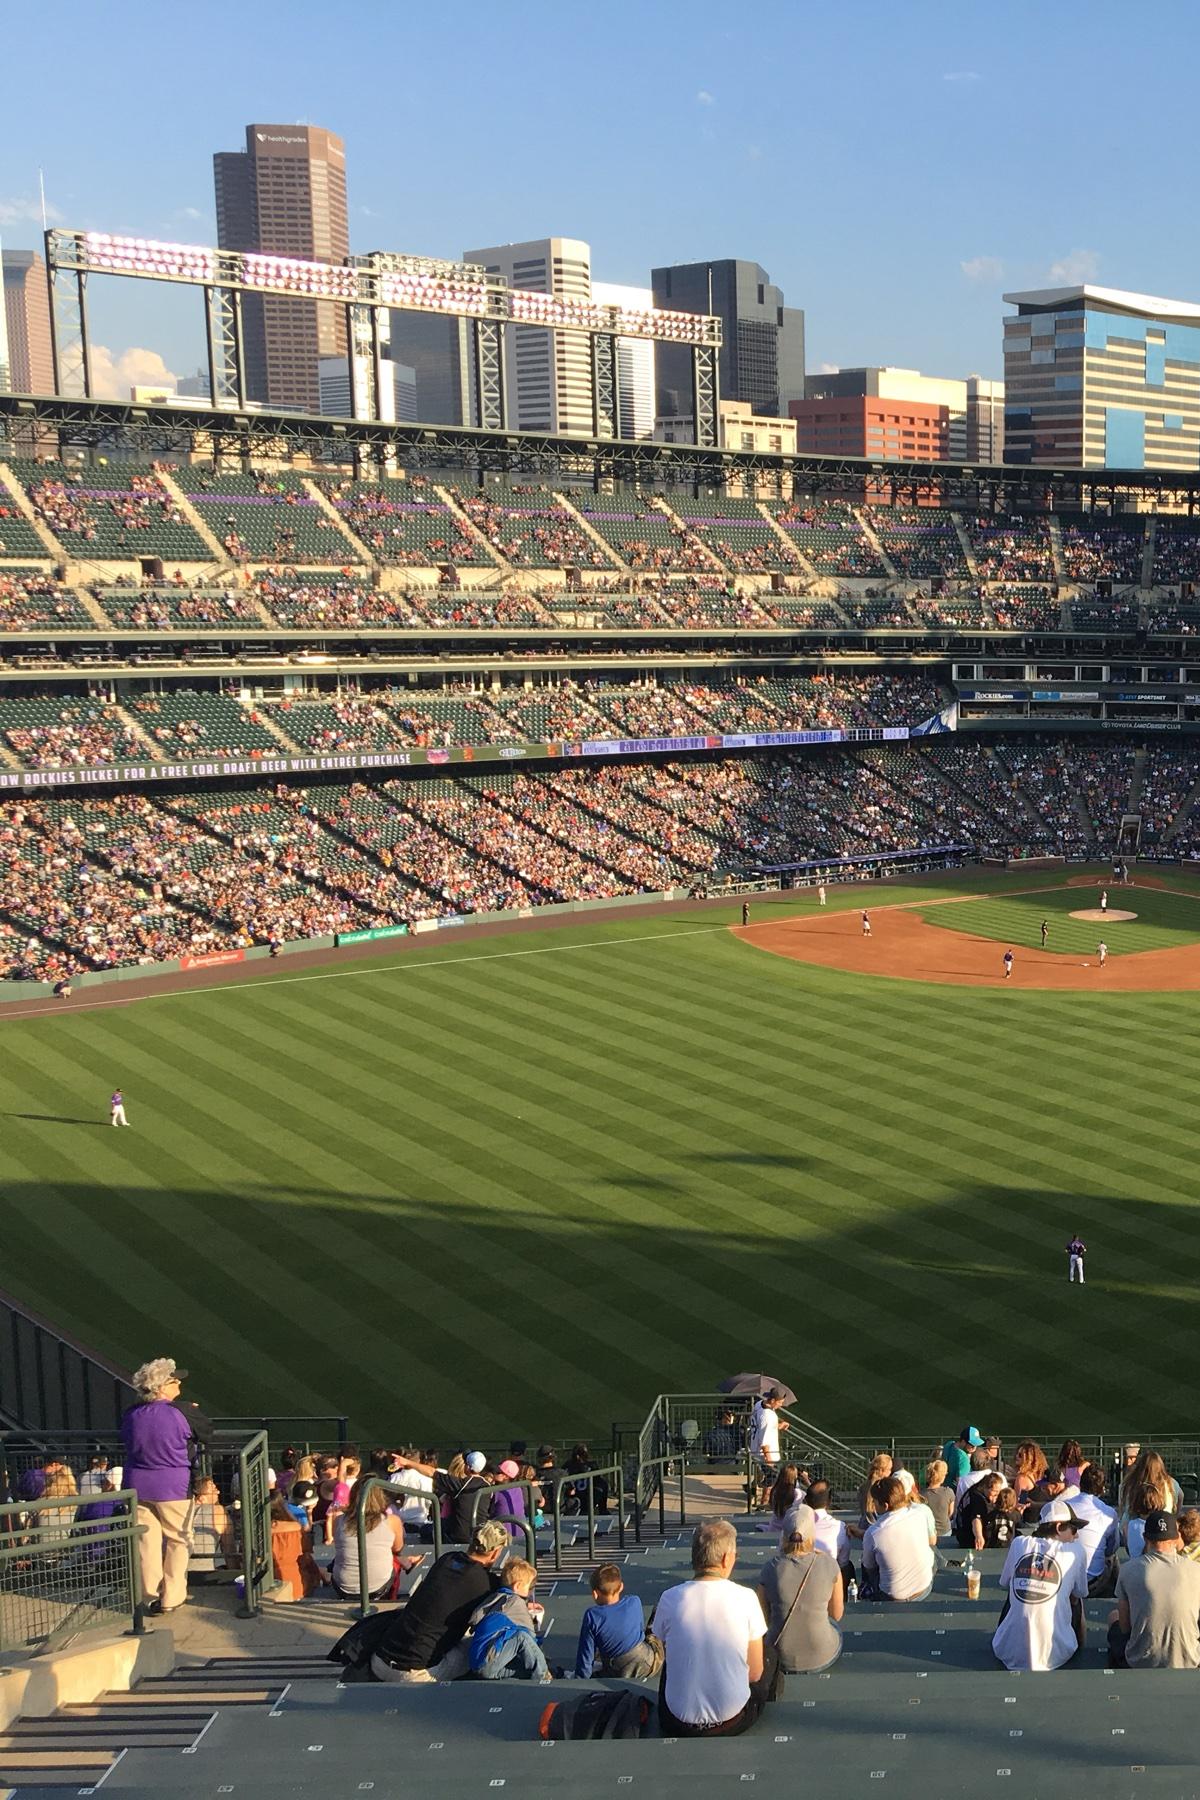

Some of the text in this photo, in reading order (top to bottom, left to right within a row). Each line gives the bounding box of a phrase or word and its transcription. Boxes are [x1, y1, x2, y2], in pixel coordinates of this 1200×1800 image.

[24, 771, 75, 785] ROCKIES
[80, 768, 119, 782] TICKET
[124, 768, 146, 779] FOR
[151, 767, 157, 778] A
[161, 765, 188, 777] FREE
[192, 763, 219, 775] CORE
[223, 762, 257, 774] DRAFT
[261, 760, 287, 772] BEER
[291, 758, 317, 770] WITH
[360, 753, 411, 766] PURCHASE
[998, 1525, 1008, 1540] 2
